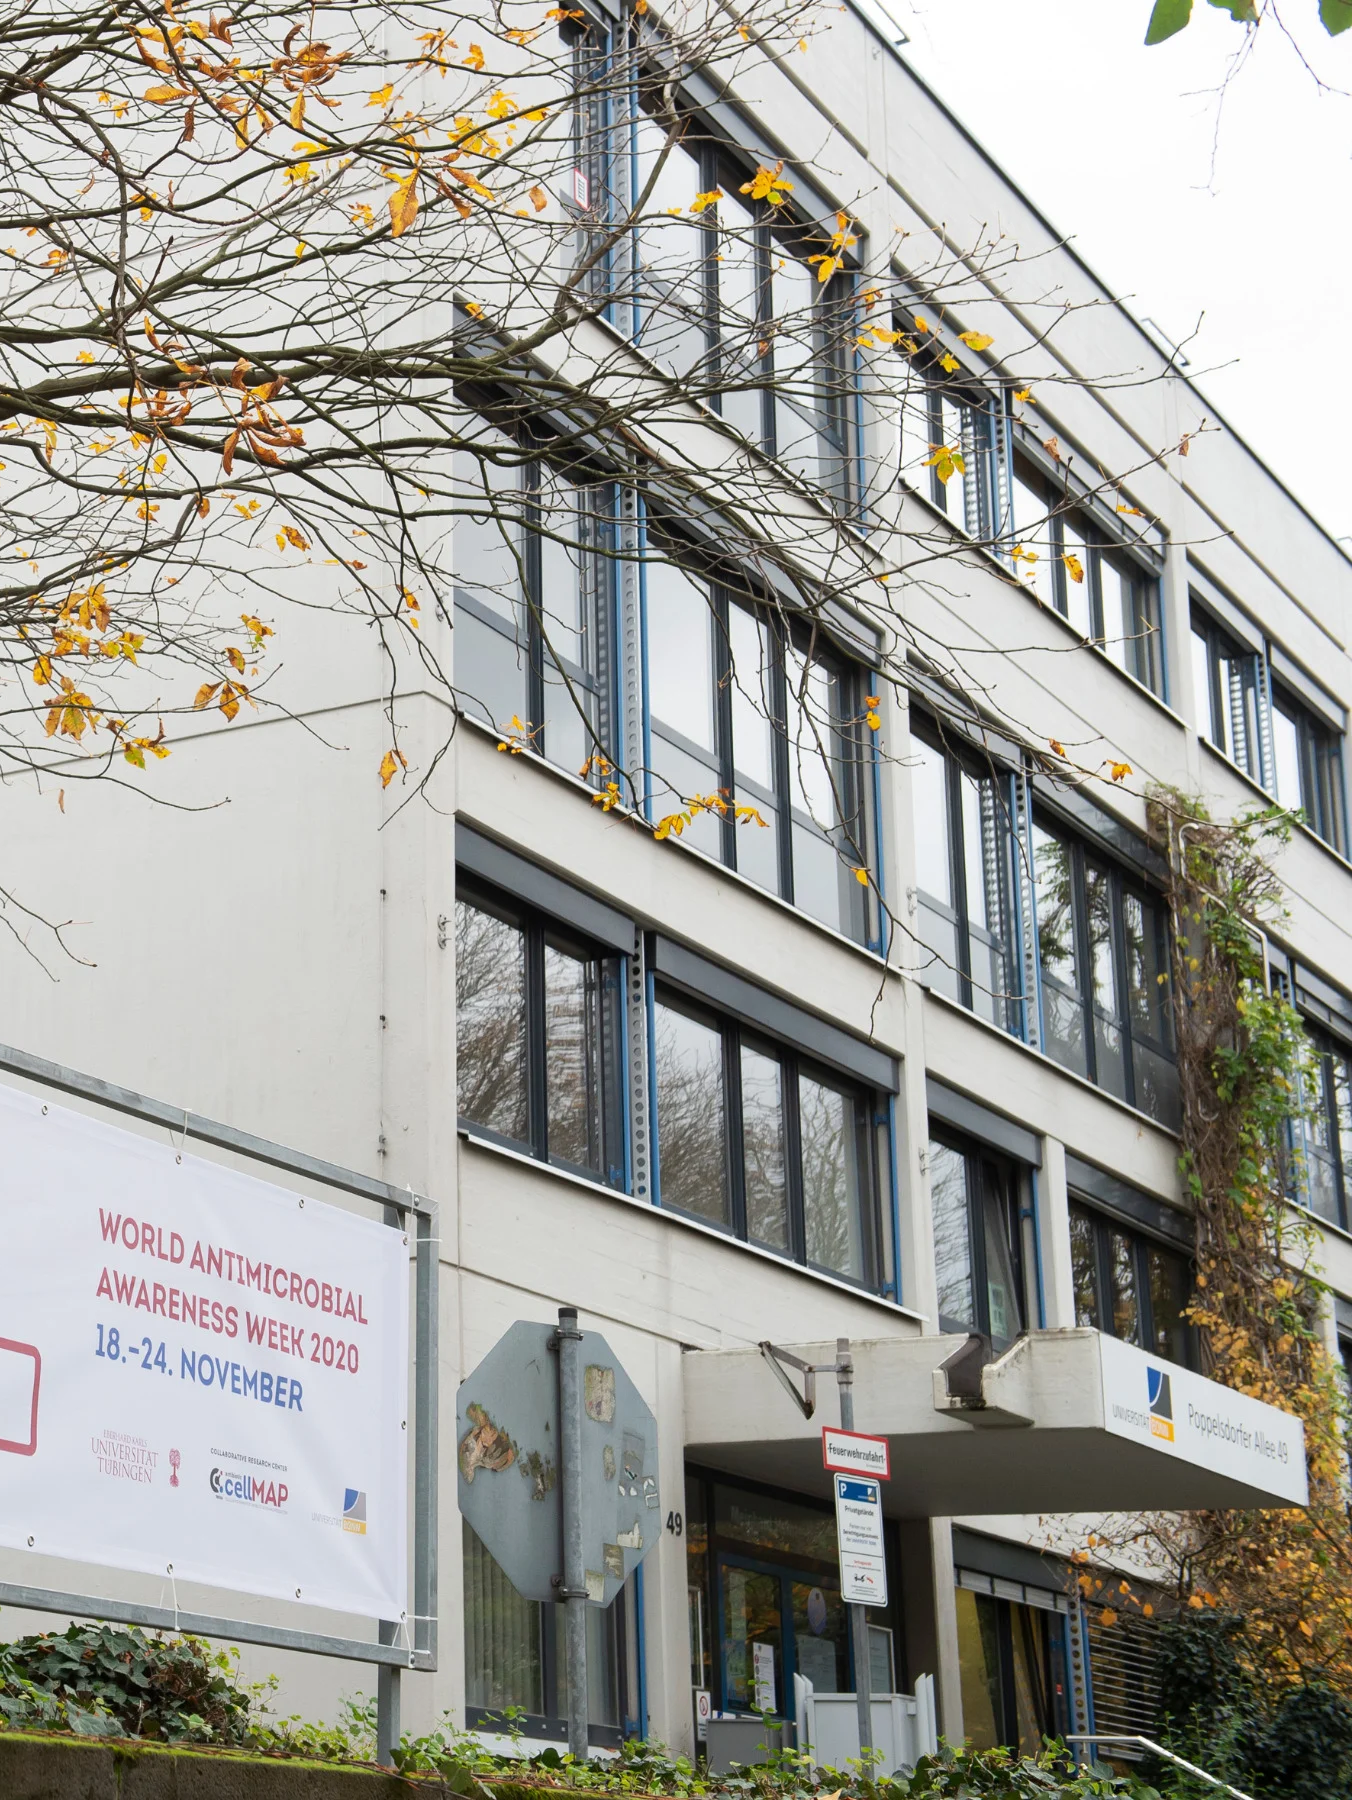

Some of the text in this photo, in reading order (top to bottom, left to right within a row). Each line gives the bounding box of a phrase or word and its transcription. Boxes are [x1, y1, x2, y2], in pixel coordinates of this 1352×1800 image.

[98, 1207, 368, 1325] WORLD ANTIMICROBIAL
[96, 1267, 359, 1374] AWARENESS WEEK 2020
[180, 1347, 304, 1412] NOVEMBER
[1112, 1404, 1150, 1430] UNIVERSITÄT
[1188, 1403, 1288, 1464] Poppelsdorfer Allee 49
[90, 1437, 159, 1468] UNIVERSITÄT
[210, 1447, 288, 1472] COLLABORATIVE RESEARCH CENTER
[97, 1456, 152, 1484] TÜBINGEN
[840, 1482, 847, 1496] P
[666, 1511, 682, 1537] 49
